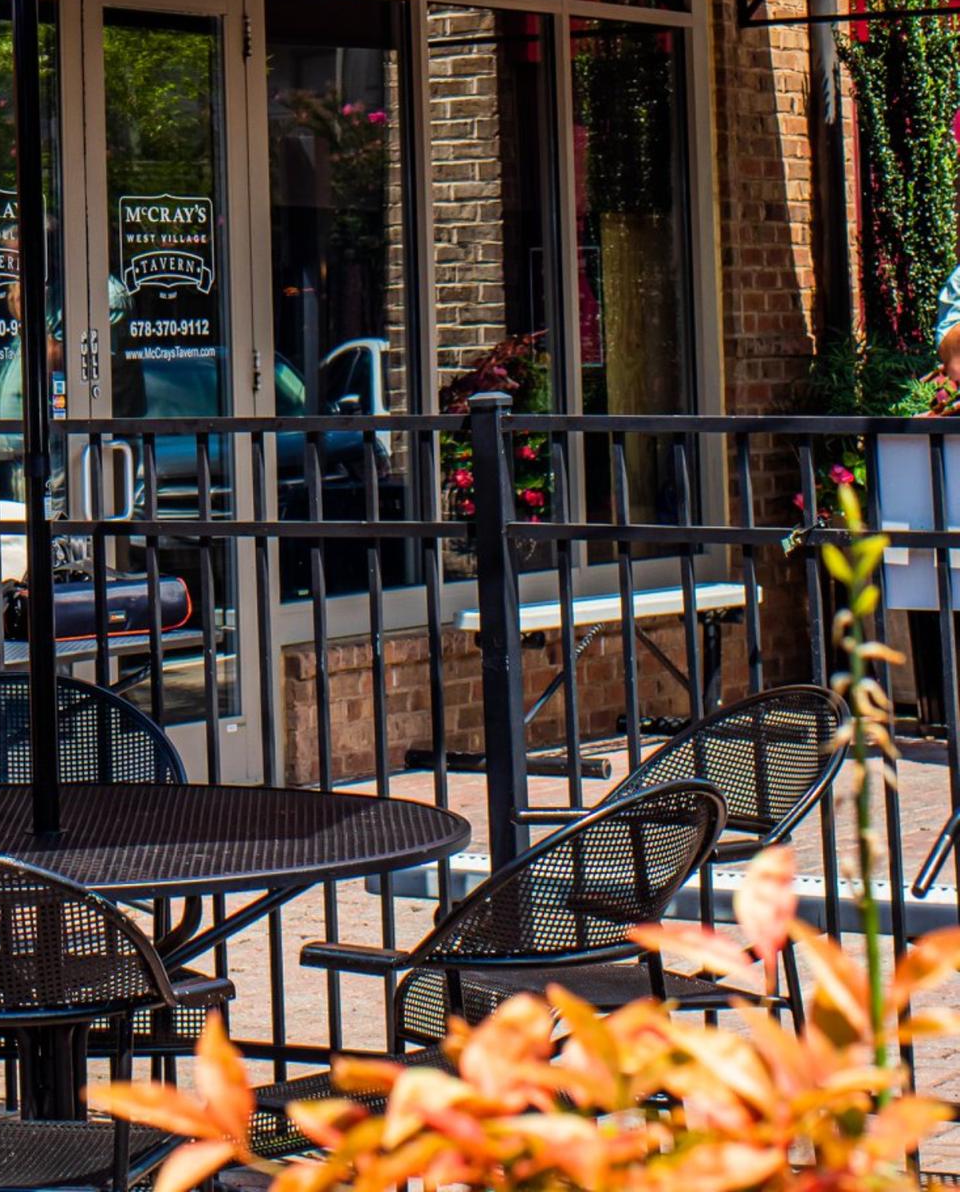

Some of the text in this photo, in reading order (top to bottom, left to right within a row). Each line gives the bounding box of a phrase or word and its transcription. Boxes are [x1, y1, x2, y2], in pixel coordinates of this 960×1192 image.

[125, 204, 207, 223] McCRAY'S
[126, 234, 207, 243] WEST VILLAGE
[140, 257, 195, 274] TAVERN
[130, 319, 210, 337] 678-370-9112
[125, 346, 215, 361] www.McCraysTavern.com
